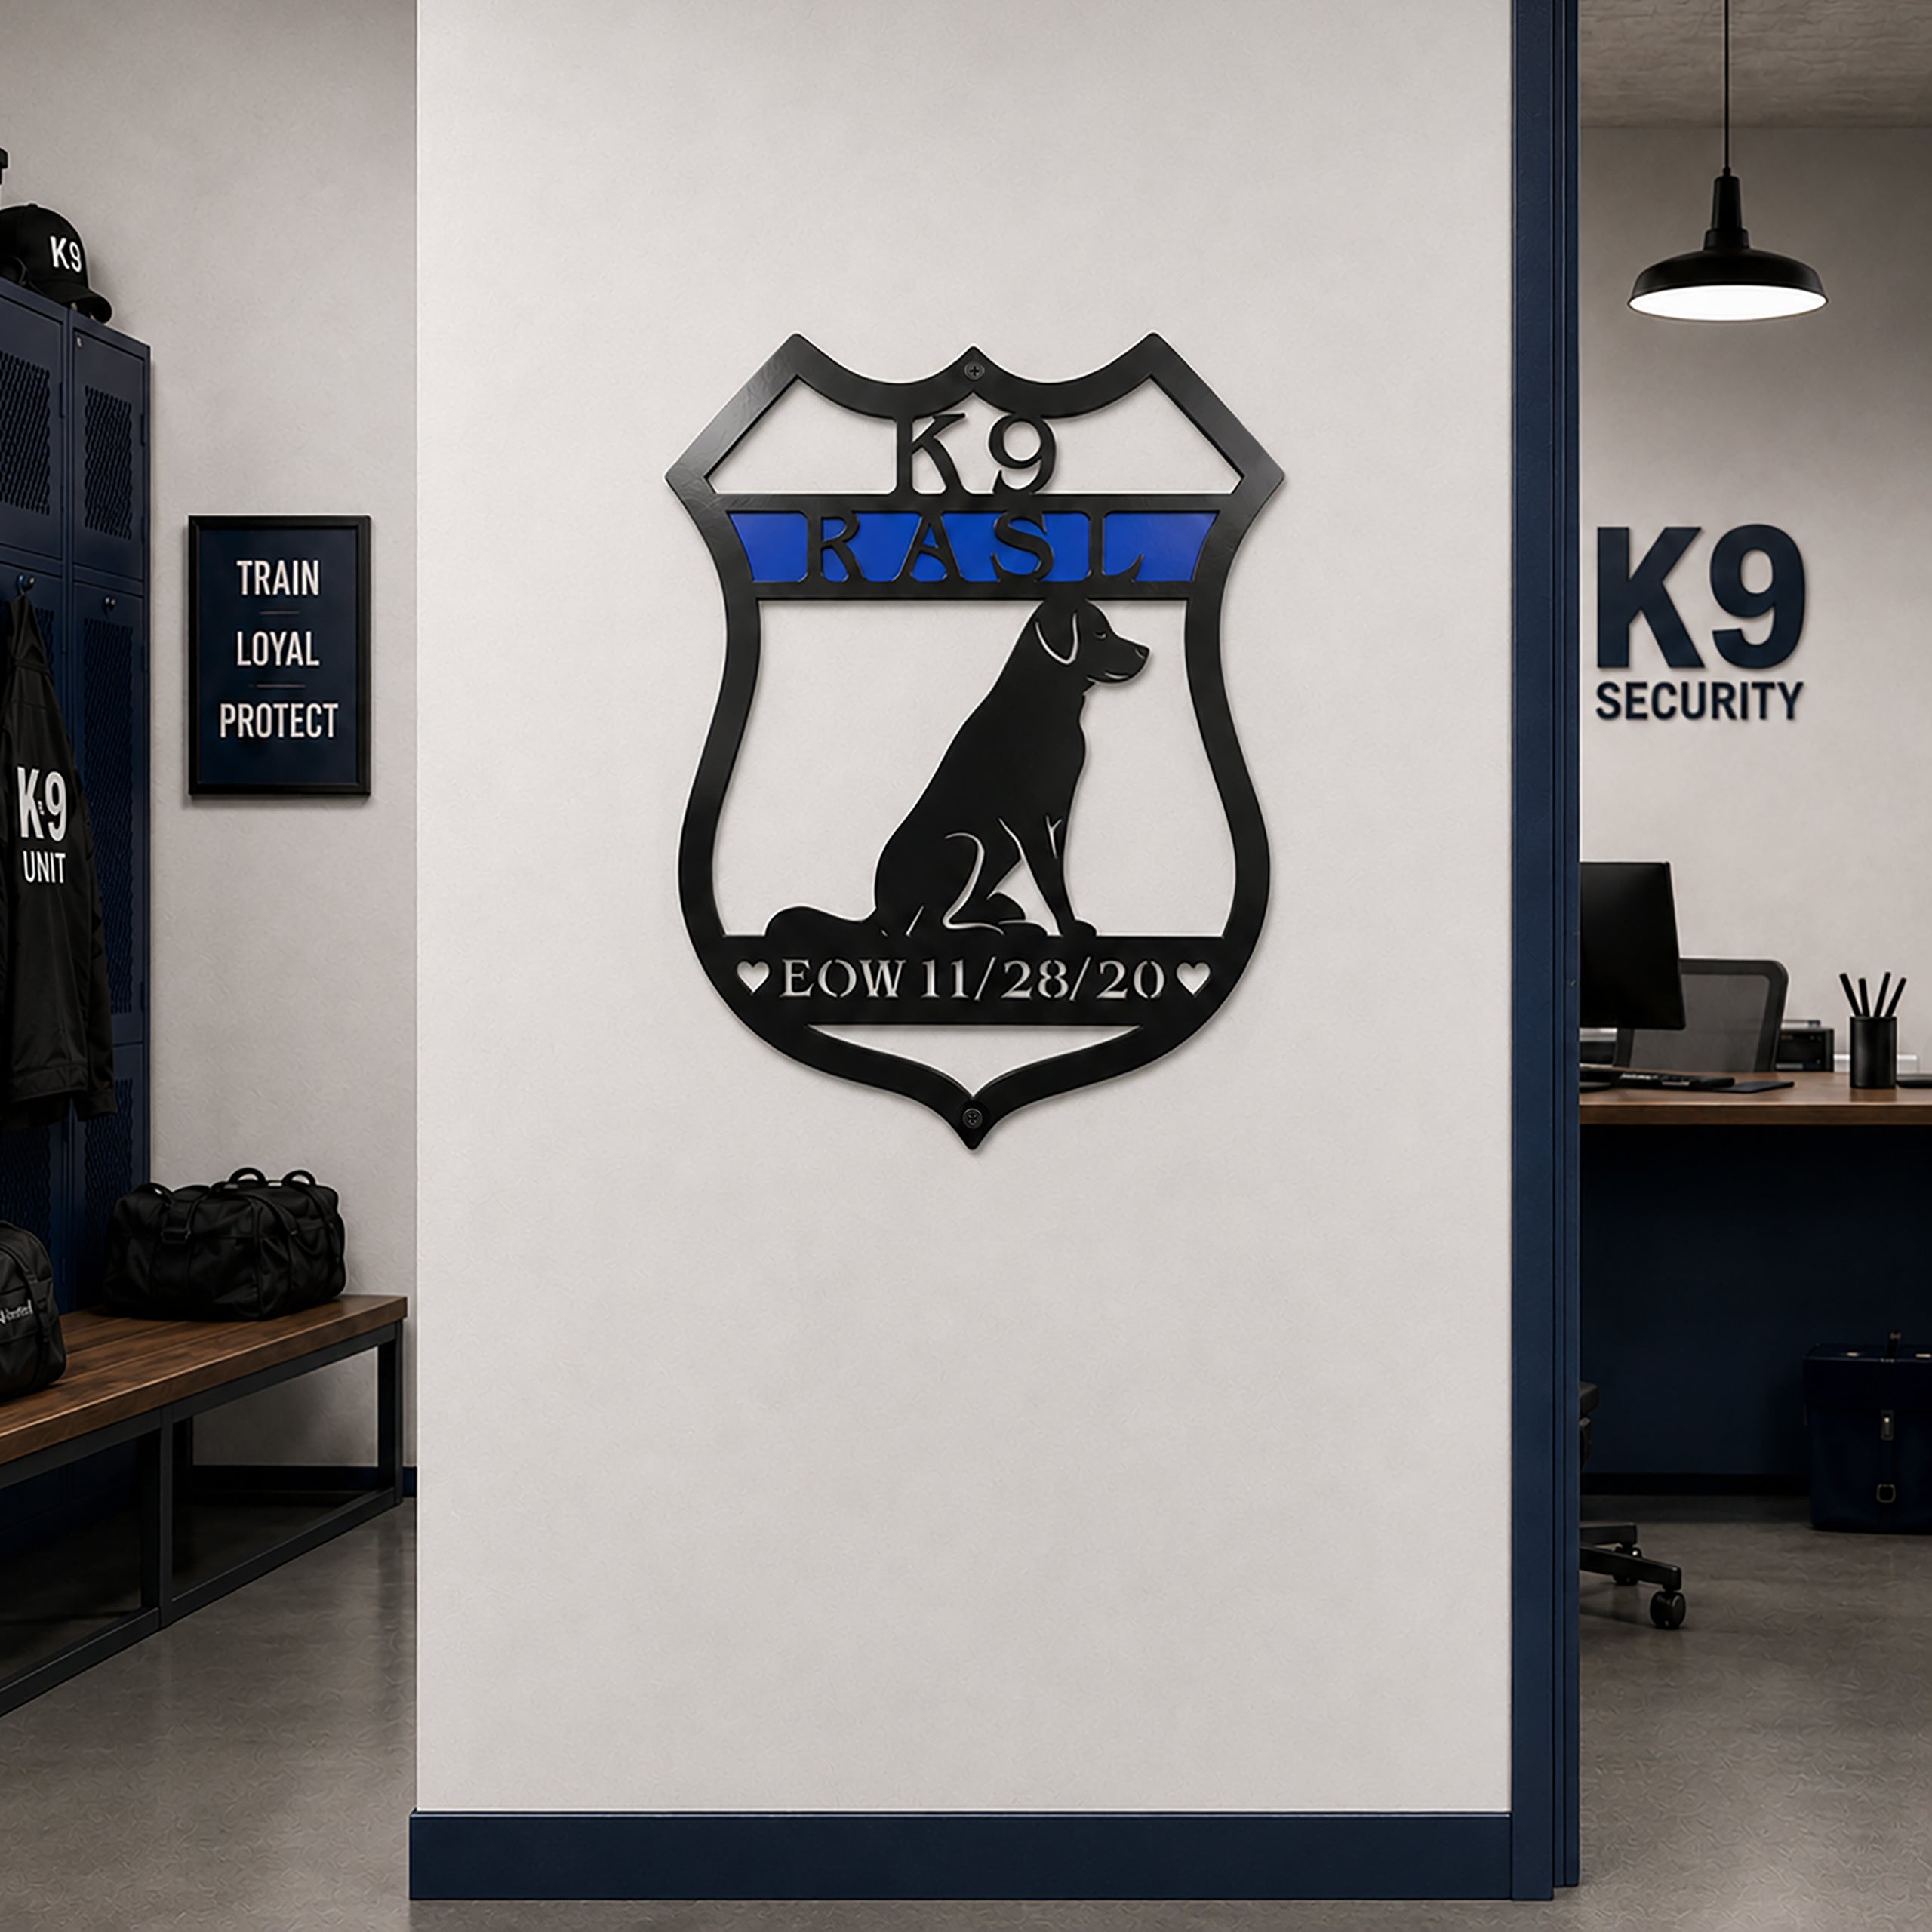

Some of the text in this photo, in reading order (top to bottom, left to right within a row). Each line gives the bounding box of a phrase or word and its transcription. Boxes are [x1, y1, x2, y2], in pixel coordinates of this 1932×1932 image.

[50, 236, 82, 272] K9
[895, 412, 1057, 495] K9
[801, 509, 1144, 584] RASL
[236, 559, 319, 595] TRAIN
[1597, 524, 1806, 669] K9
[237, 631, 320, 666] LOYAL
[1595, 681, 1804, 721] SECURITY
[220, 703, 339, 738] PROTECT
[23, 850, 66, 884] UNIT
[782, 956, 1165, 1001] EOW 11/28/20
